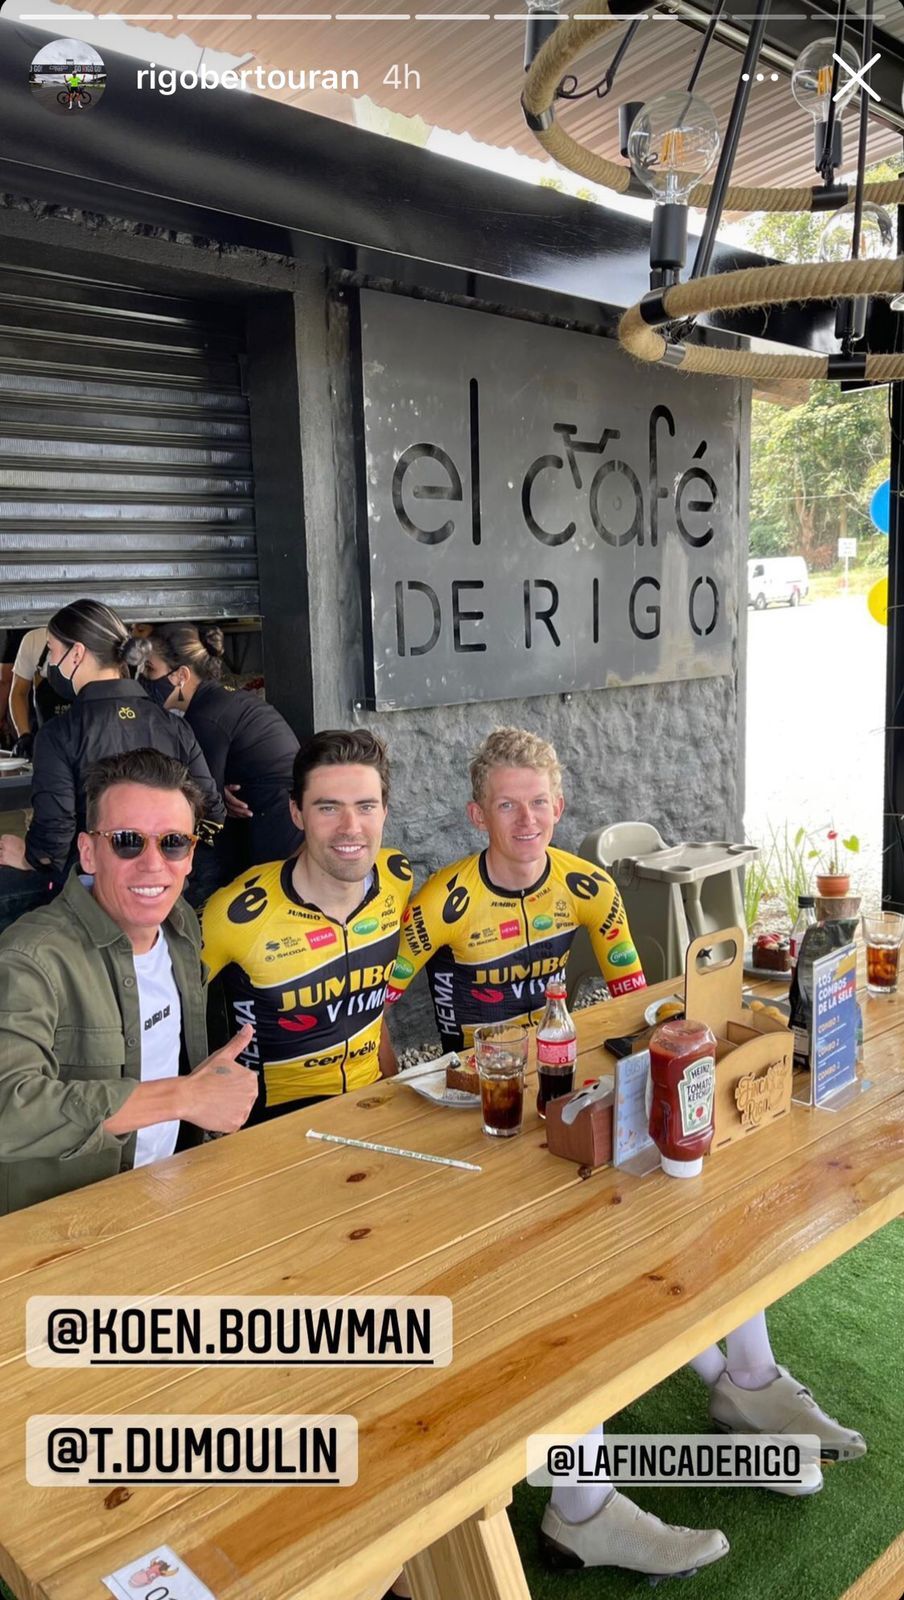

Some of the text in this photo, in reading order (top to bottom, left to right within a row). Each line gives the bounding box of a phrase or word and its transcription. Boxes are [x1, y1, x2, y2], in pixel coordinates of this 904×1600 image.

[392, 377, 719, 548] el café
[395, 575, 720, 657] DE RIGO
[287, 908, 321, 921] JUMBO
[310, 931, 334, 945] HEMA
[412, 904, 433, 952] JUMBO
[472, 951, 571, 985] JUMBO
[277, 959, 397, 1013] JUMBO
[818, 973, 832, 988] LOS
[818, 977, 847, 1001] COMBOS
[434, 971, 461, 1036] HEMA
[818, 1001, 828, 1016] DE
[828, 995, 838, 1010] LA
[691, 1064, 710, 1079] HEINZ
[686, 1076, 712, 1096] TOMATO
